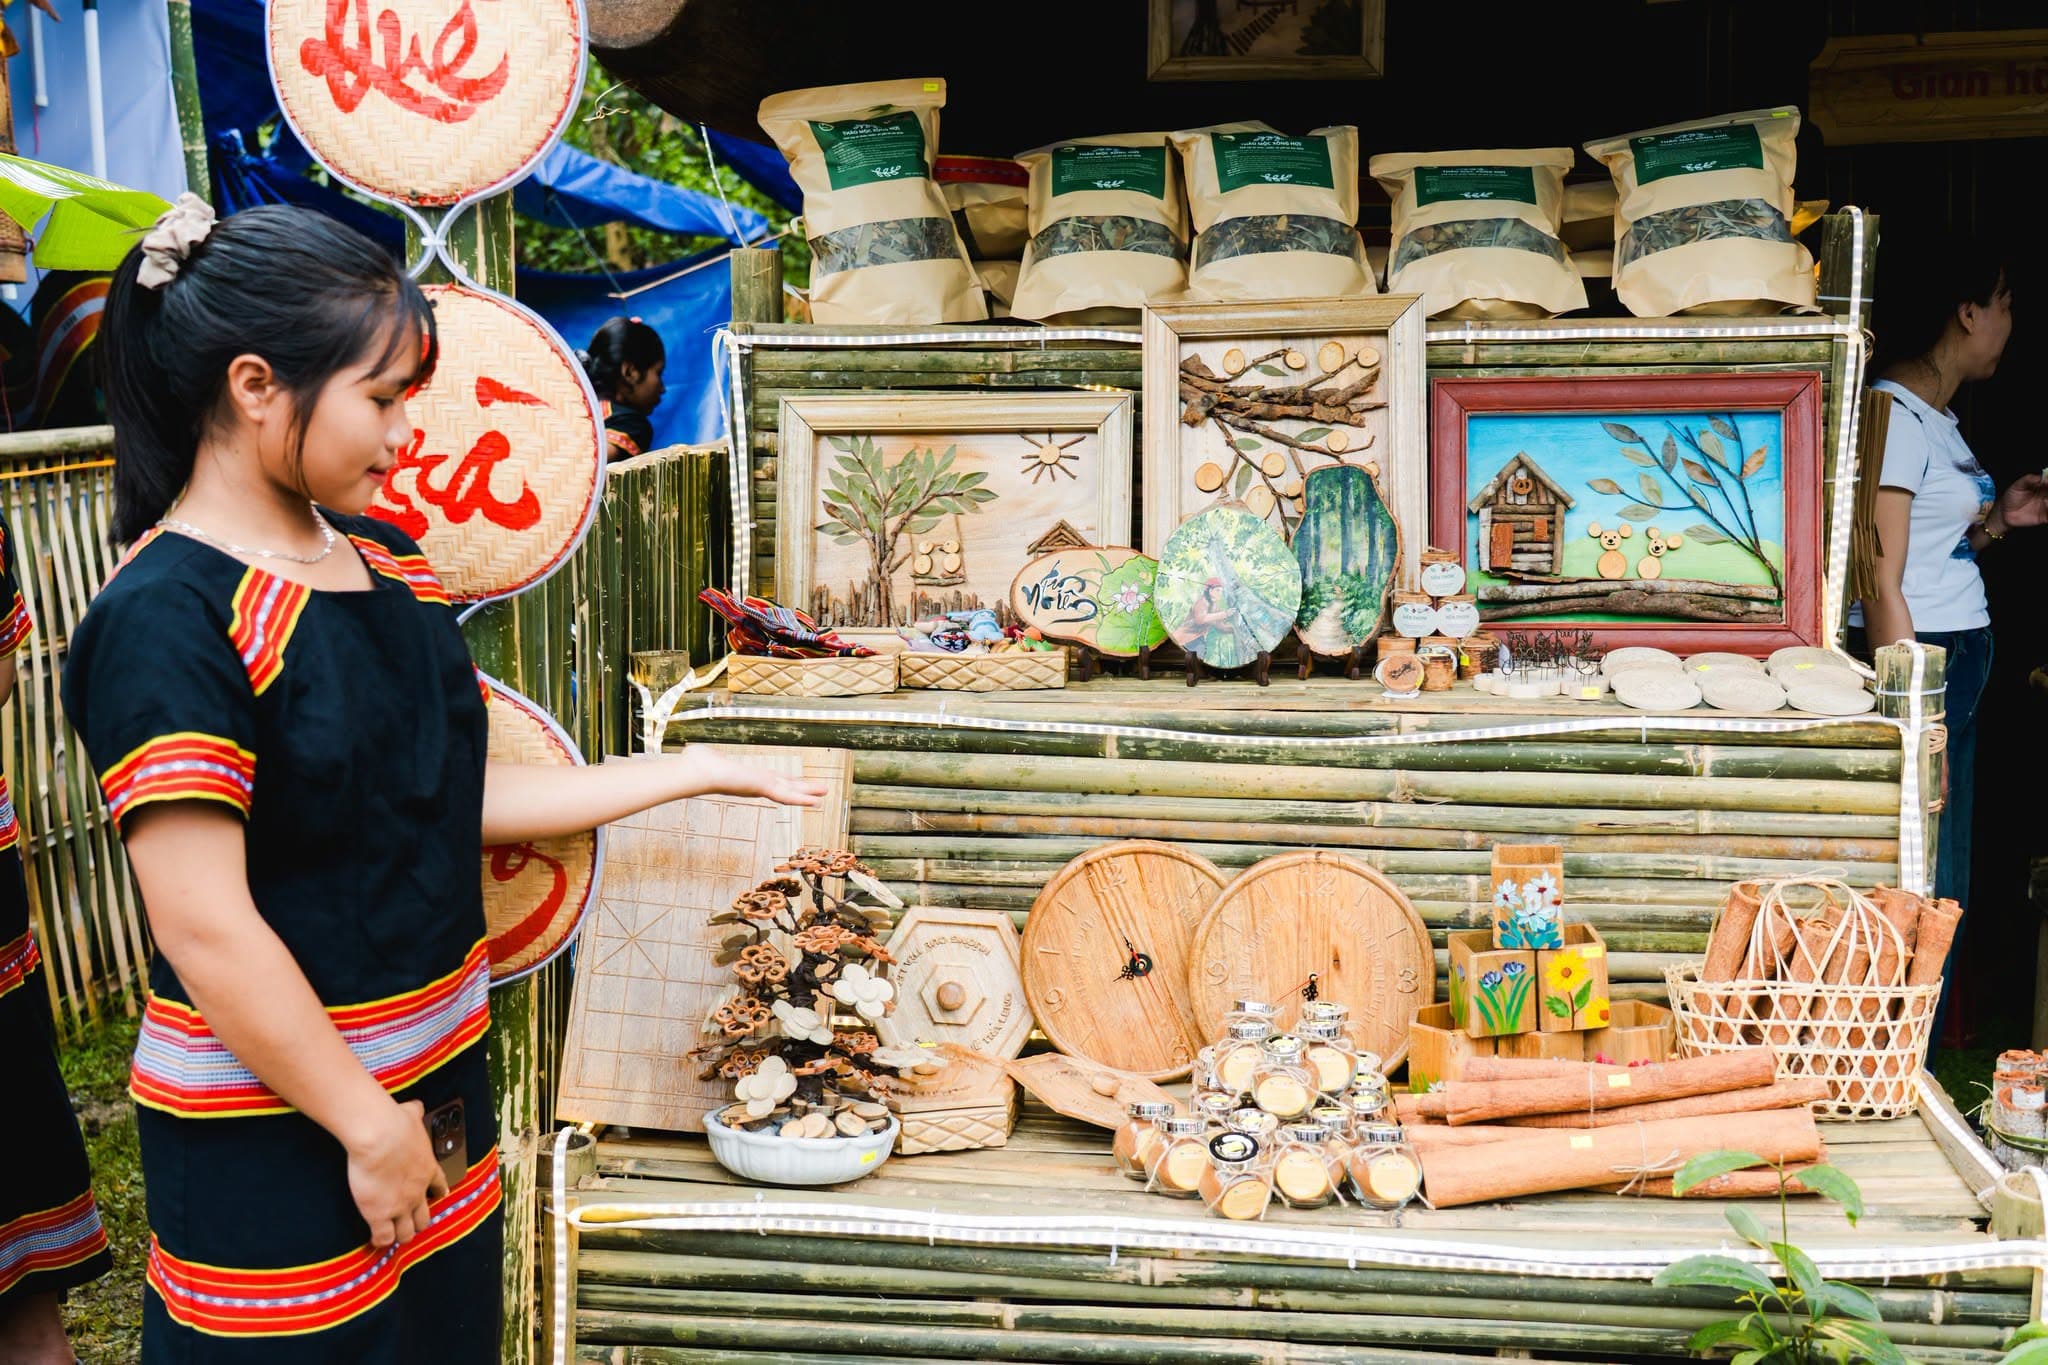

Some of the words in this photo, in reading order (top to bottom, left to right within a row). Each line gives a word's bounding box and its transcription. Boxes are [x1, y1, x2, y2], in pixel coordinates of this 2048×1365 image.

[1893, 63, 1990, 99] Gian
[1205, 961, 1230, 986] 9
[1397, 968, 1419, 994] 3
[1044, 987, 1066, 1013] 9
